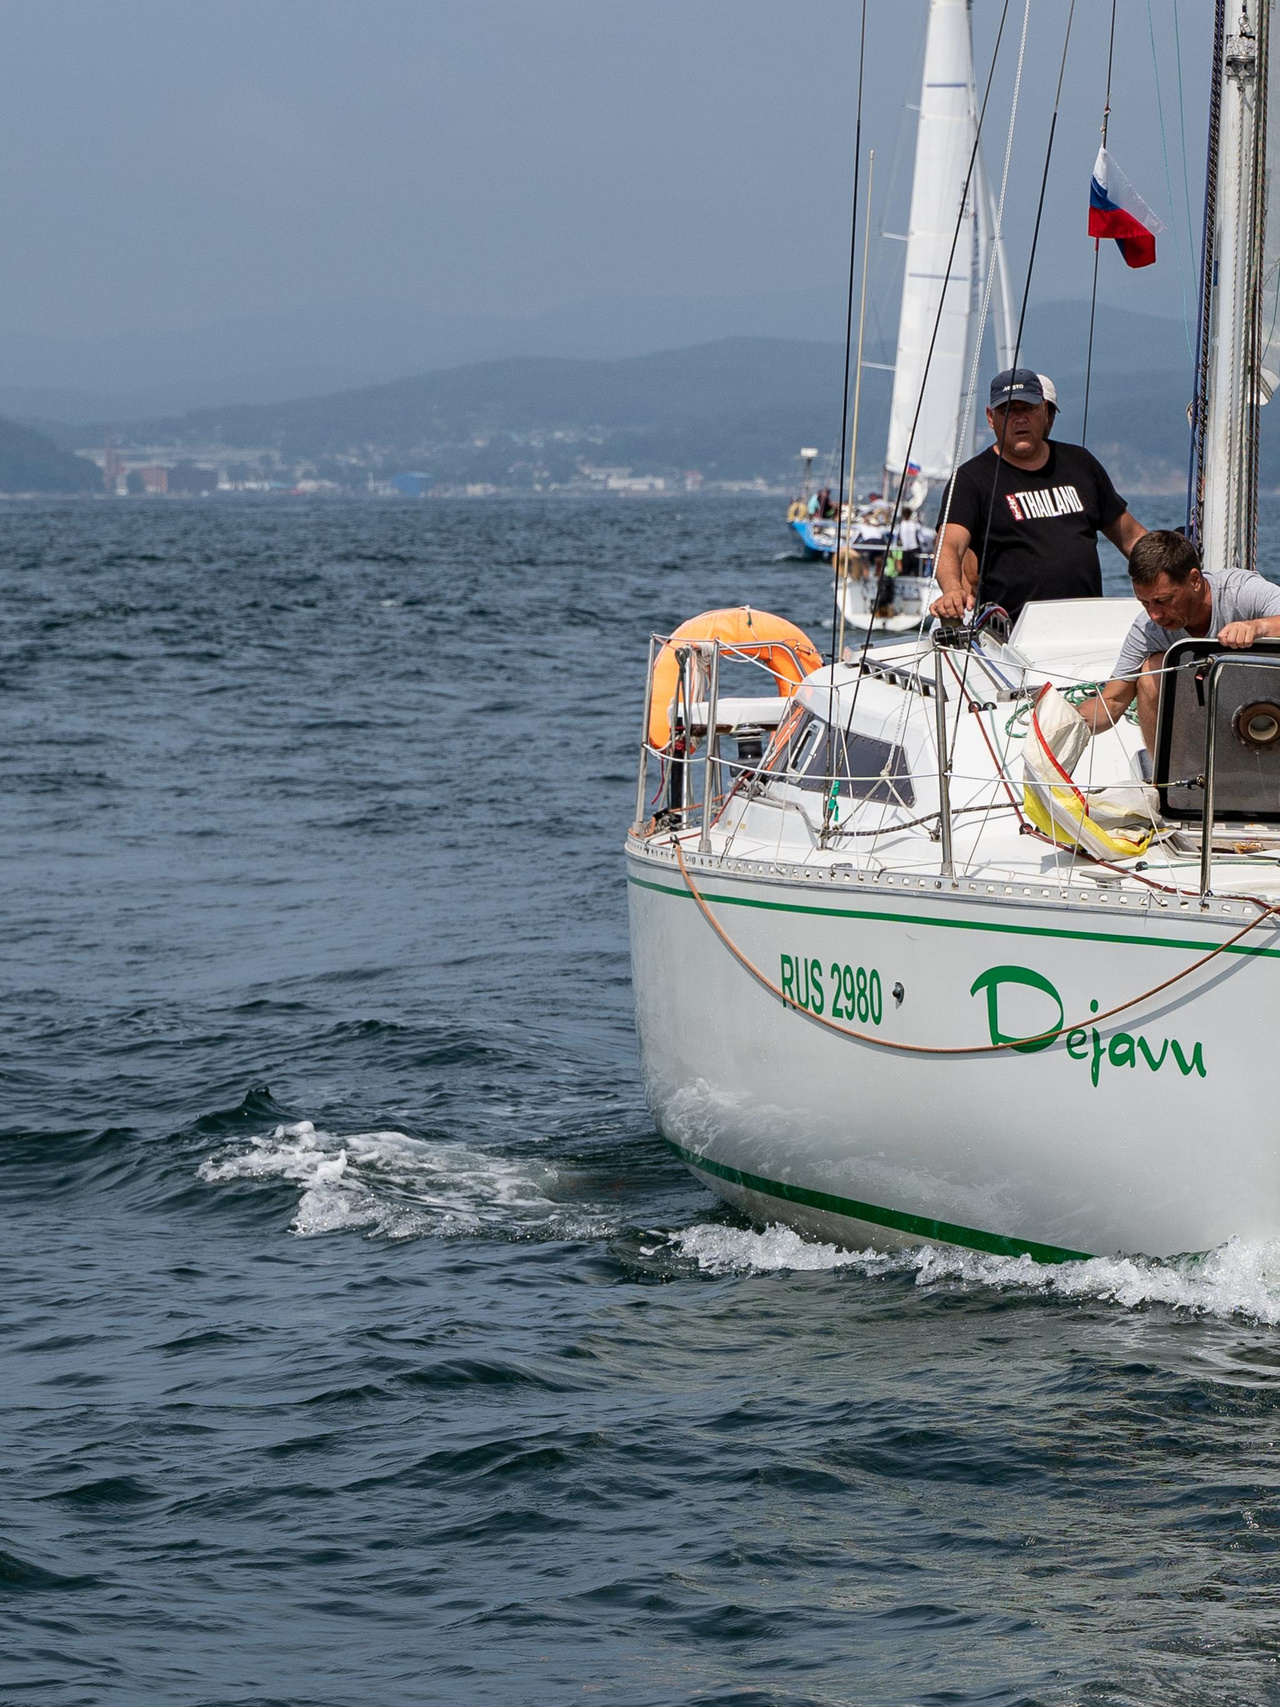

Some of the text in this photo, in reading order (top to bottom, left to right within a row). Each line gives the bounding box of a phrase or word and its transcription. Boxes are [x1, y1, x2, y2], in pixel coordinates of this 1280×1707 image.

[1002, 383, 1025, 392] MSTO
[1014, 485, 1084, 519] THAILAND
[780, 953, 882, 1026] RUS 2980
[970, 965, 1207, 1088] Dejavu
